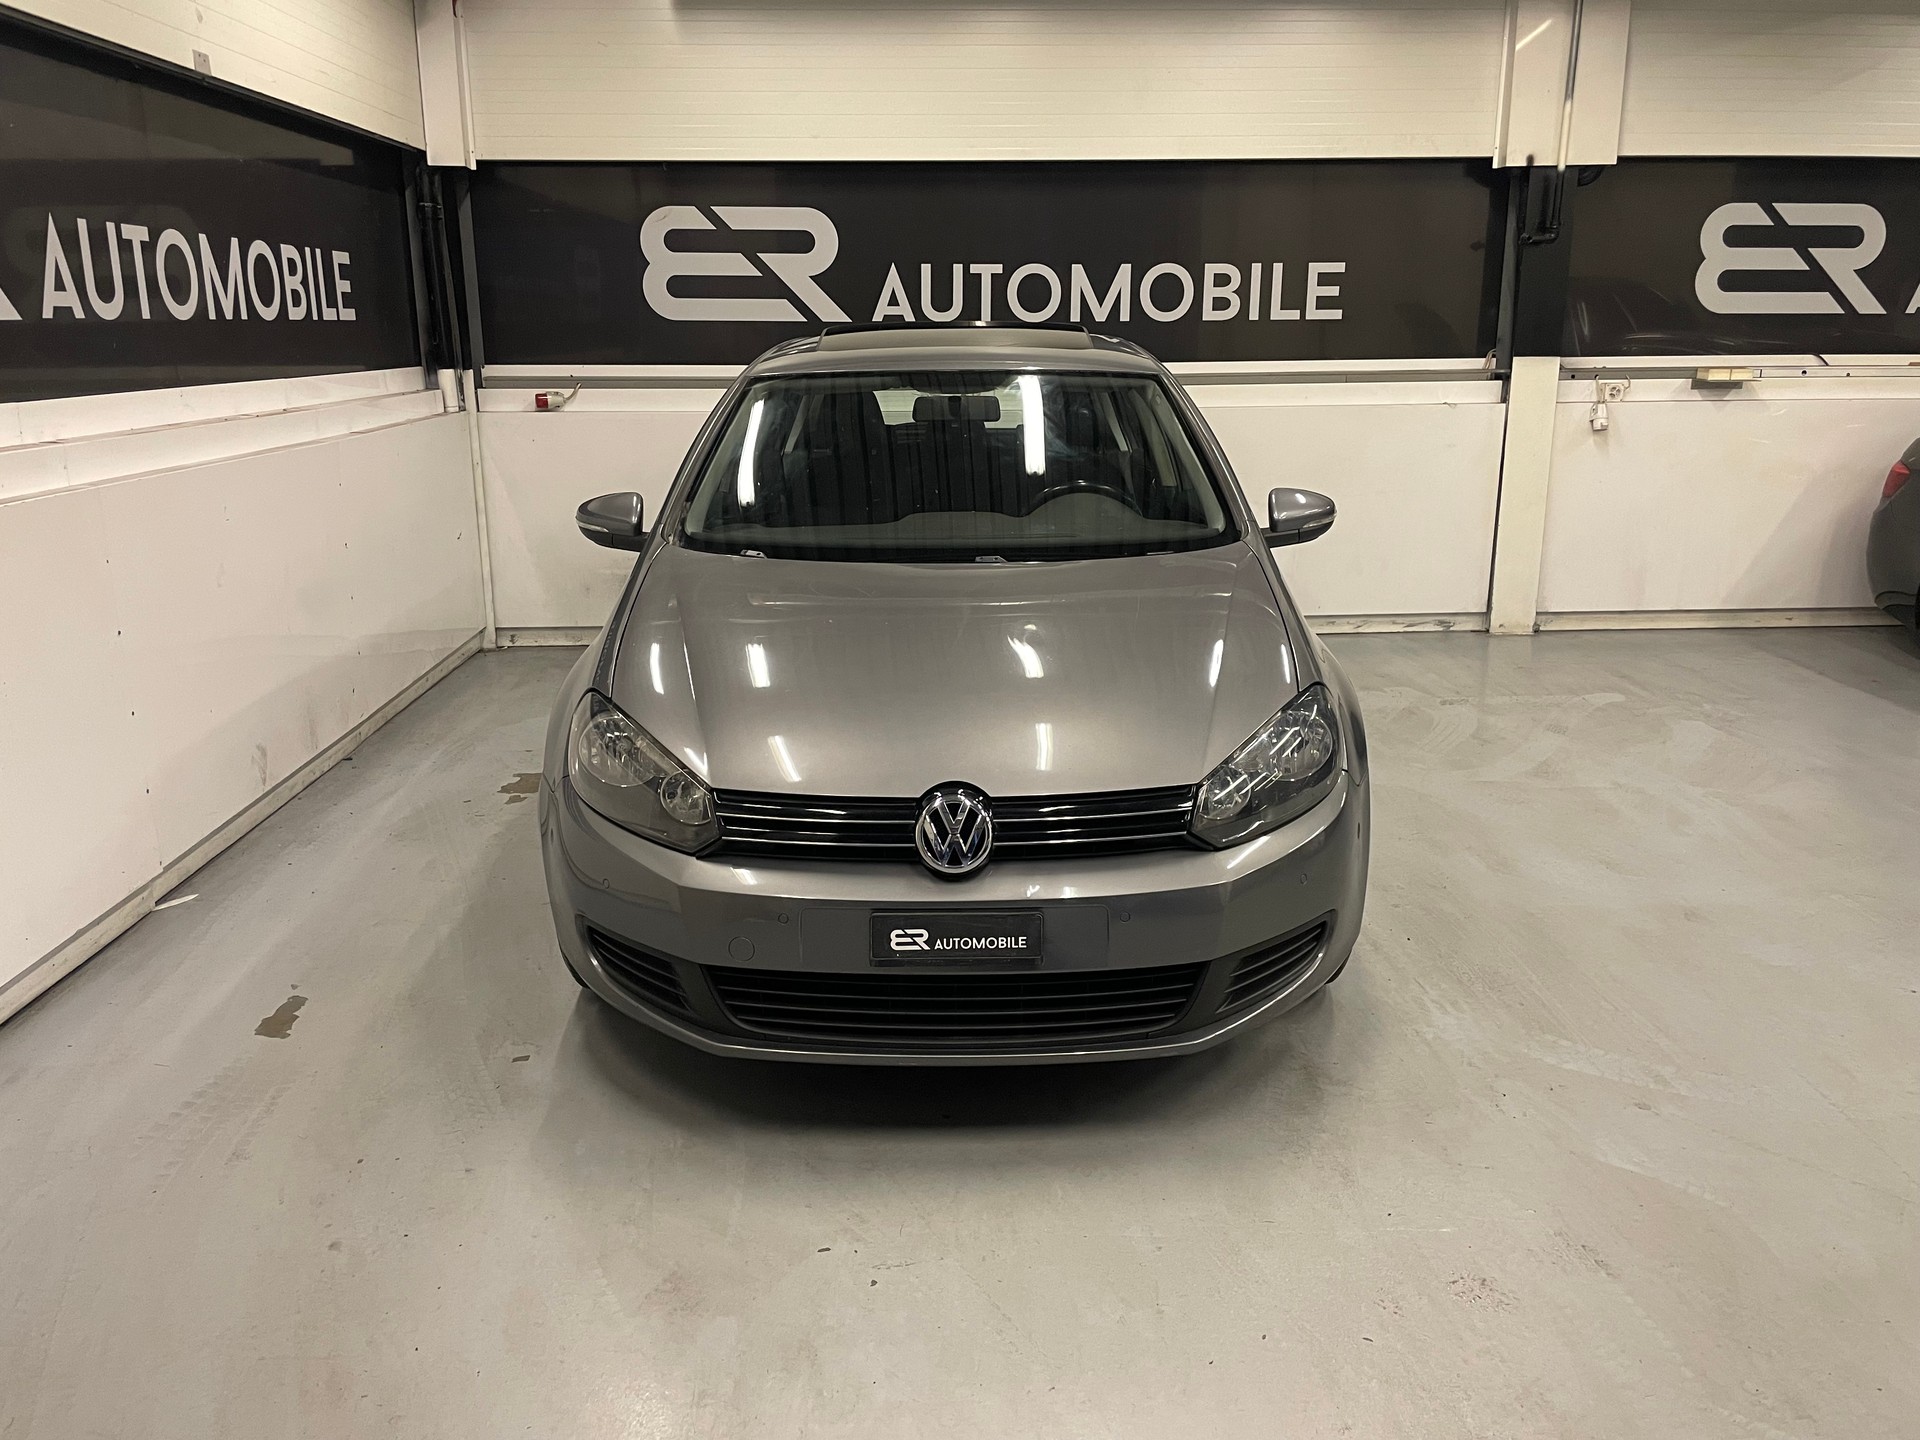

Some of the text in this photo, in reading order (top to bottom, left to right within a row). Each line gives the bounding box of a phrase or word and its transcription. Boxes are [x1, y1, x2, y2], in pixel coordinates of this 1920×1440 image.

[42, 213, 356, 321] AUTOMOBILE
[872, 262, 1346, 322] AUTOMOBILE
[934, 937, 1027, 950] AUTOMOBILE
